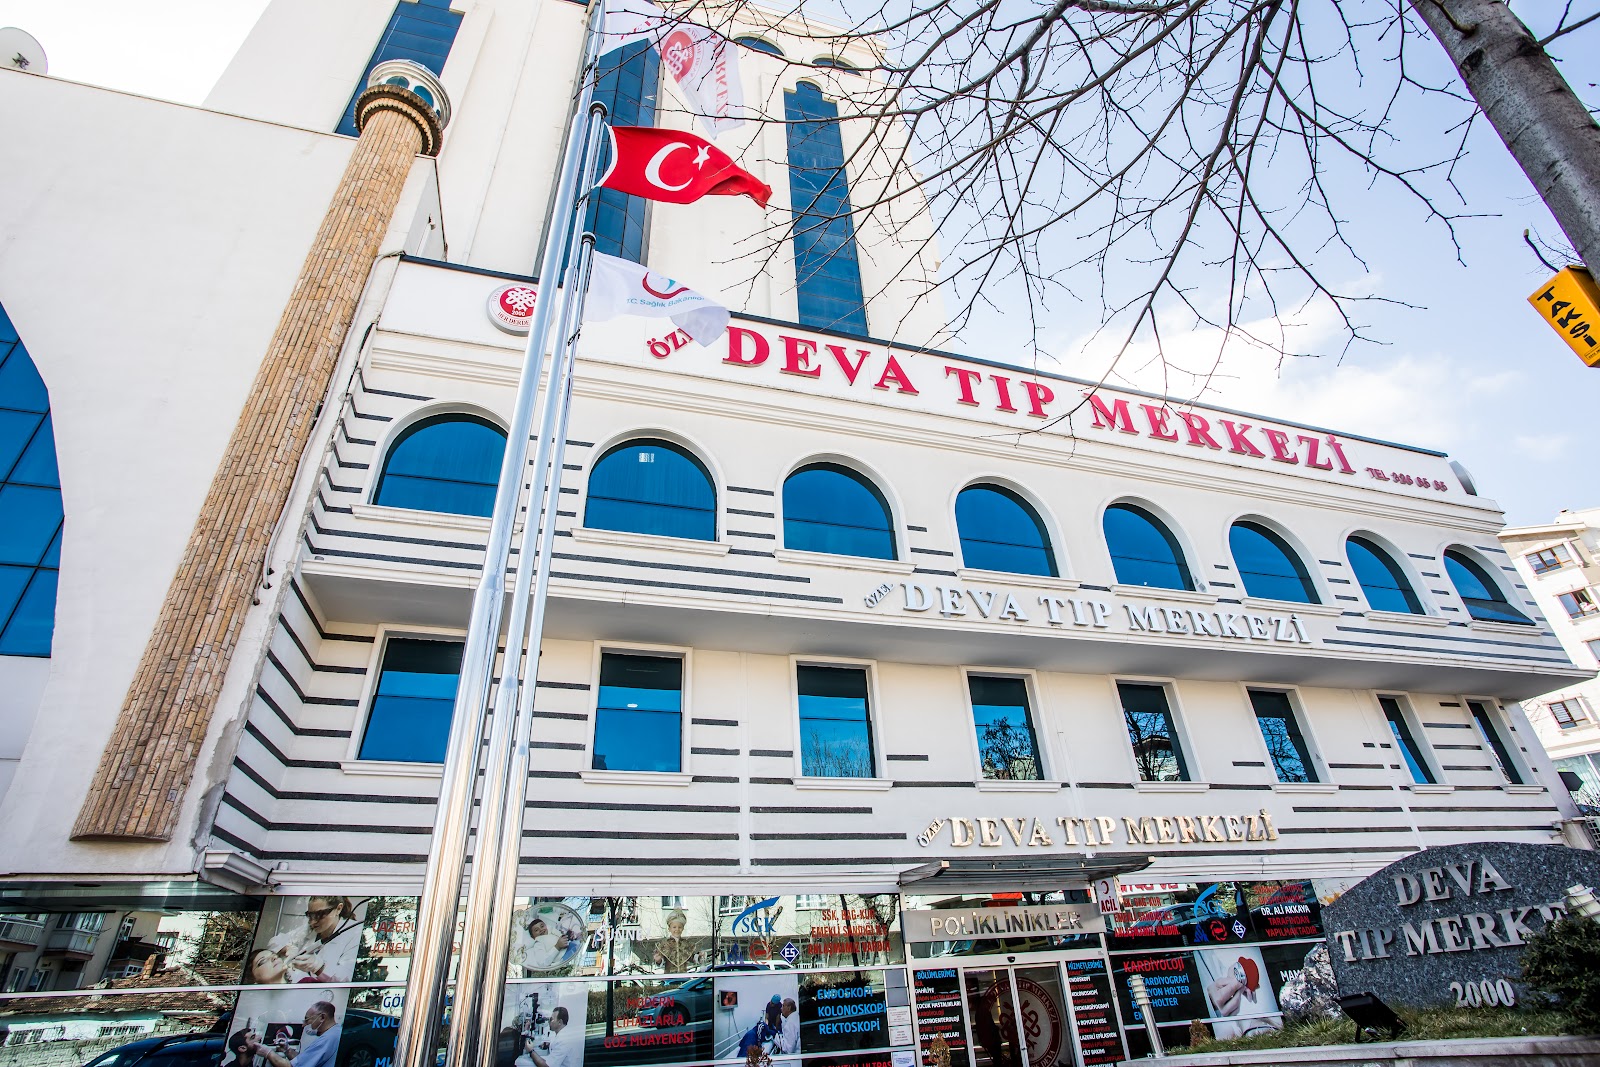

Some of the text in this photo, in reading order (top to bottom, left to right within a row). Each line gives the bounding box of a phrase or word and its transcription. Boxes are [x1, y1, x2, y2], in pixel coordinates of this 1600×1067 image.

[639, 298, 666, 308] Sağlık
[1537, 285, 1597, 348] TAKSİ
[646, 326, 1356, 475] ÖZ DEVA TIP MERKEZİ
[1364, 467, 1390, 481] TEL
[900, 582, 1029, 622] DEVA
[1038, 595, 1113, 628] TIP
[1123, 604, 1312, 644] MERKEZİ
[916, 808, 1279, 848] ÖZEL DEVA TIP MERKEZİ
[1390, 855, 1514, 907] DEVA
[1101, 896, 1118, 912] ACİL
[1261, 904, 1311, 916] DR. ALİ AKKAYA
[741, 917, 777, 933] SGK
[930, 909, 1084, 937] POLİKLİNİKLER
[1268, 915, 1310, 926] TARAFINDAN
[1334, 927, 1395, 962] TIP
[1123, 956, 1185, 973] KARDİYOLOJİ
[816, 985, 874, 999] ENDOSKOPİ
[1164, 985, 1191, 997] HOLTER
[1450, 979, 1516, 1008] 2000
[626, 996, 676, 1009] MODERN
[817, 1000, 887, 1017] KOLONOSKOPİ
[1152, 997, 1179, 1008] HOLTER
[615, 1013, 685, 1028] CİHAZLARLA
[818, 1018, 881, 1035] REKTOSKOPİ
[604, 1030, 695, 1048] GÖZ MUAYENESİ
